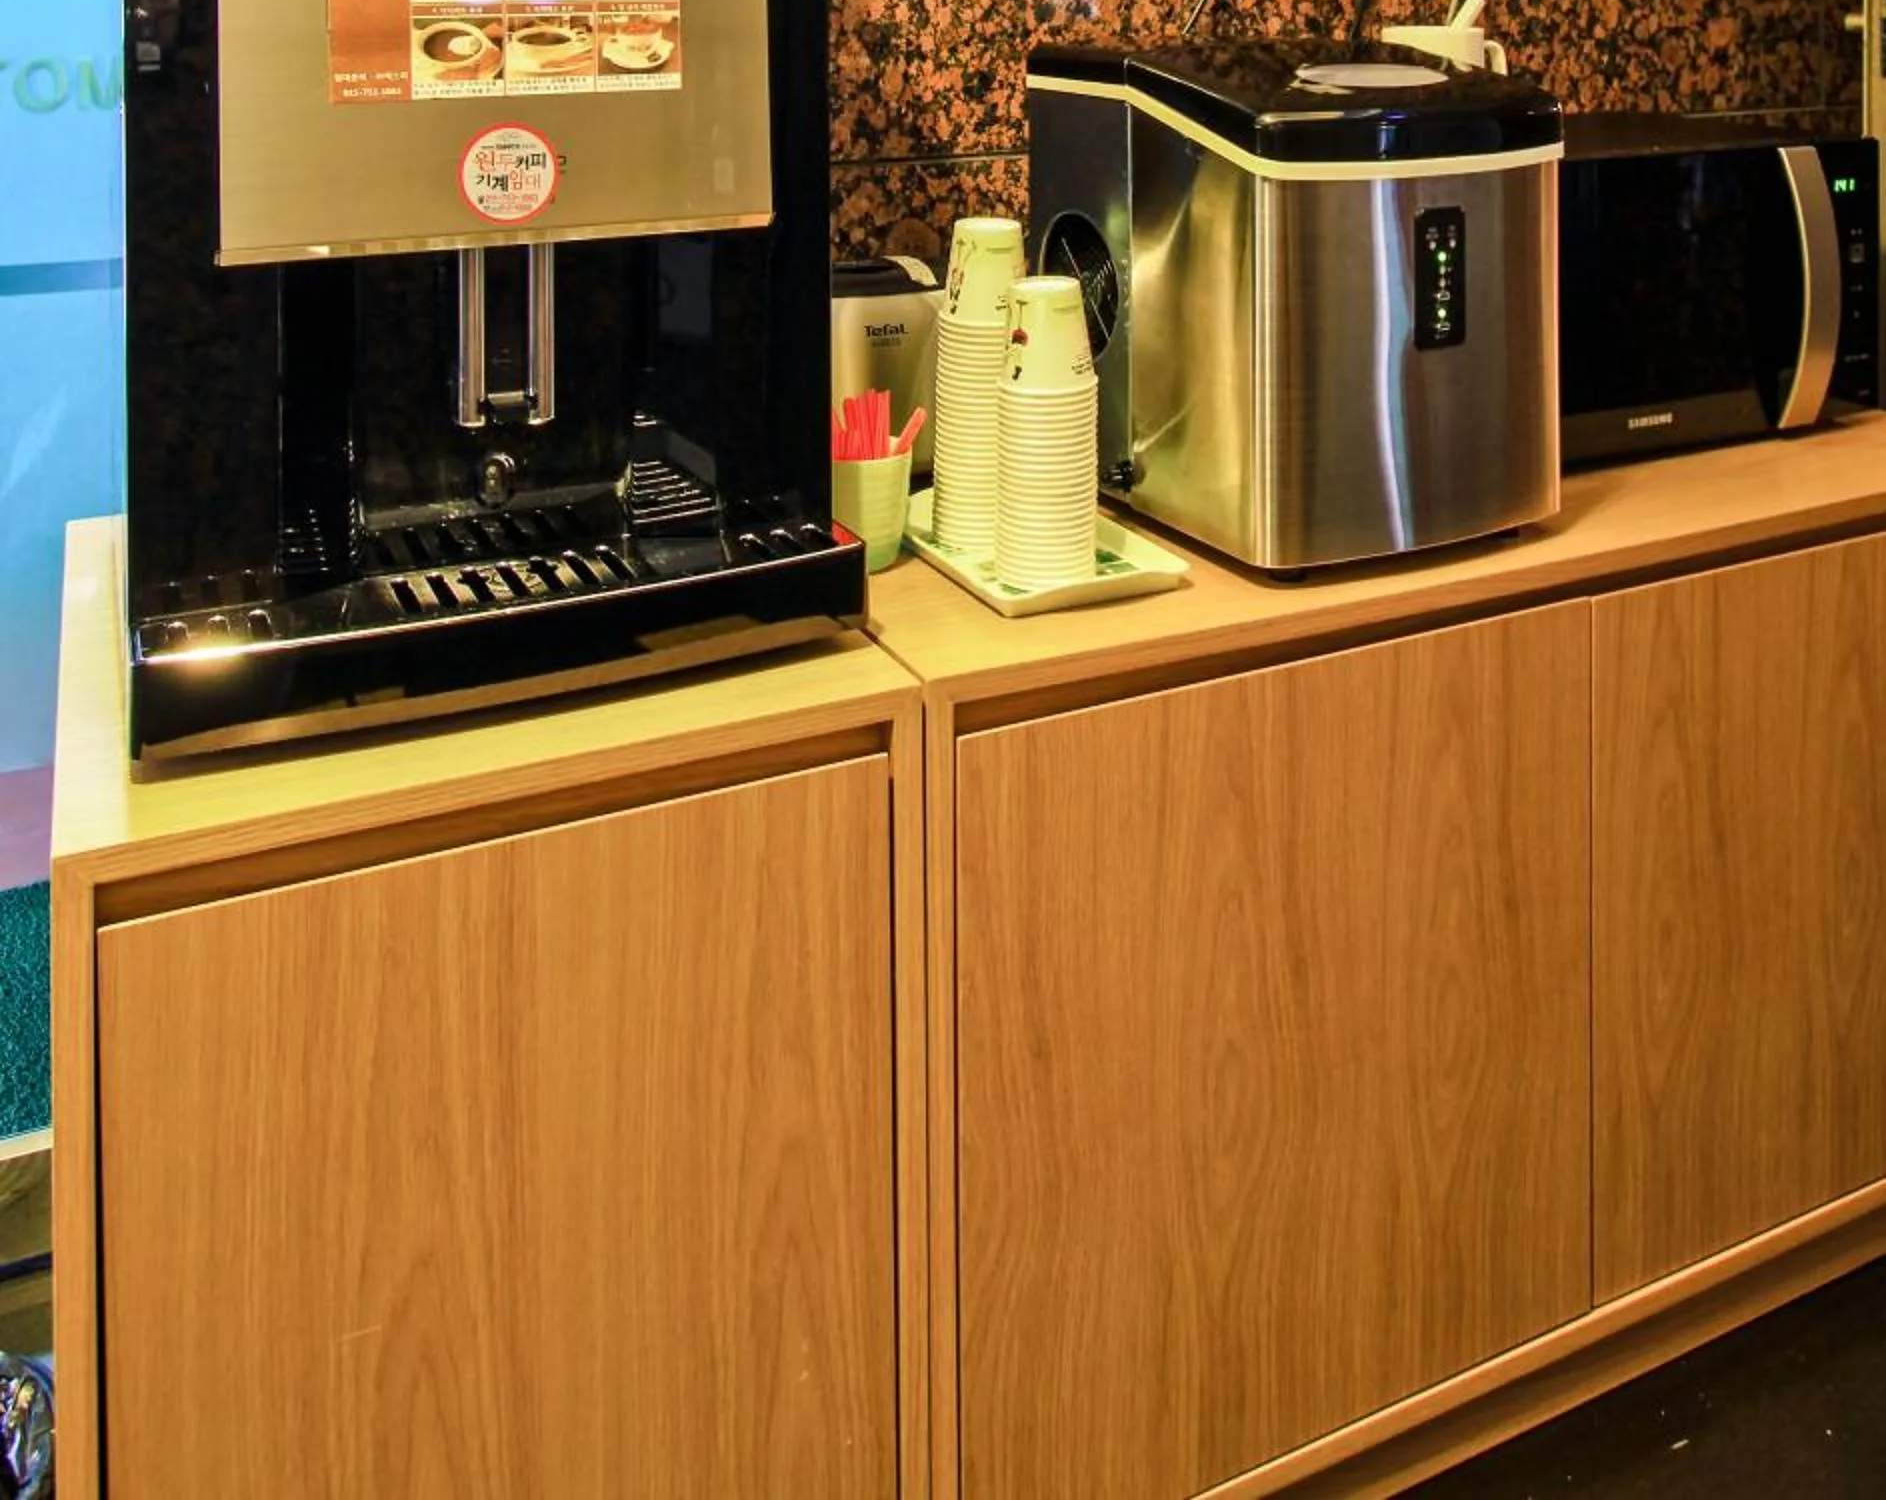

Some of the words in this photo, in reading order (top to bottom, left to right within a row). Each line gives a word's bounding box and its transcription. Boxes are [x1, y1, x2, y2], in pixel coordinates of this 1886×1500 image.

[475, 150, 547, 172] 원두커피
[475, 168, 541, 192] 기계임대
[863, 323, 909, 337] Tefal
[1628, 412, 1673, 430] SAMSUNG
